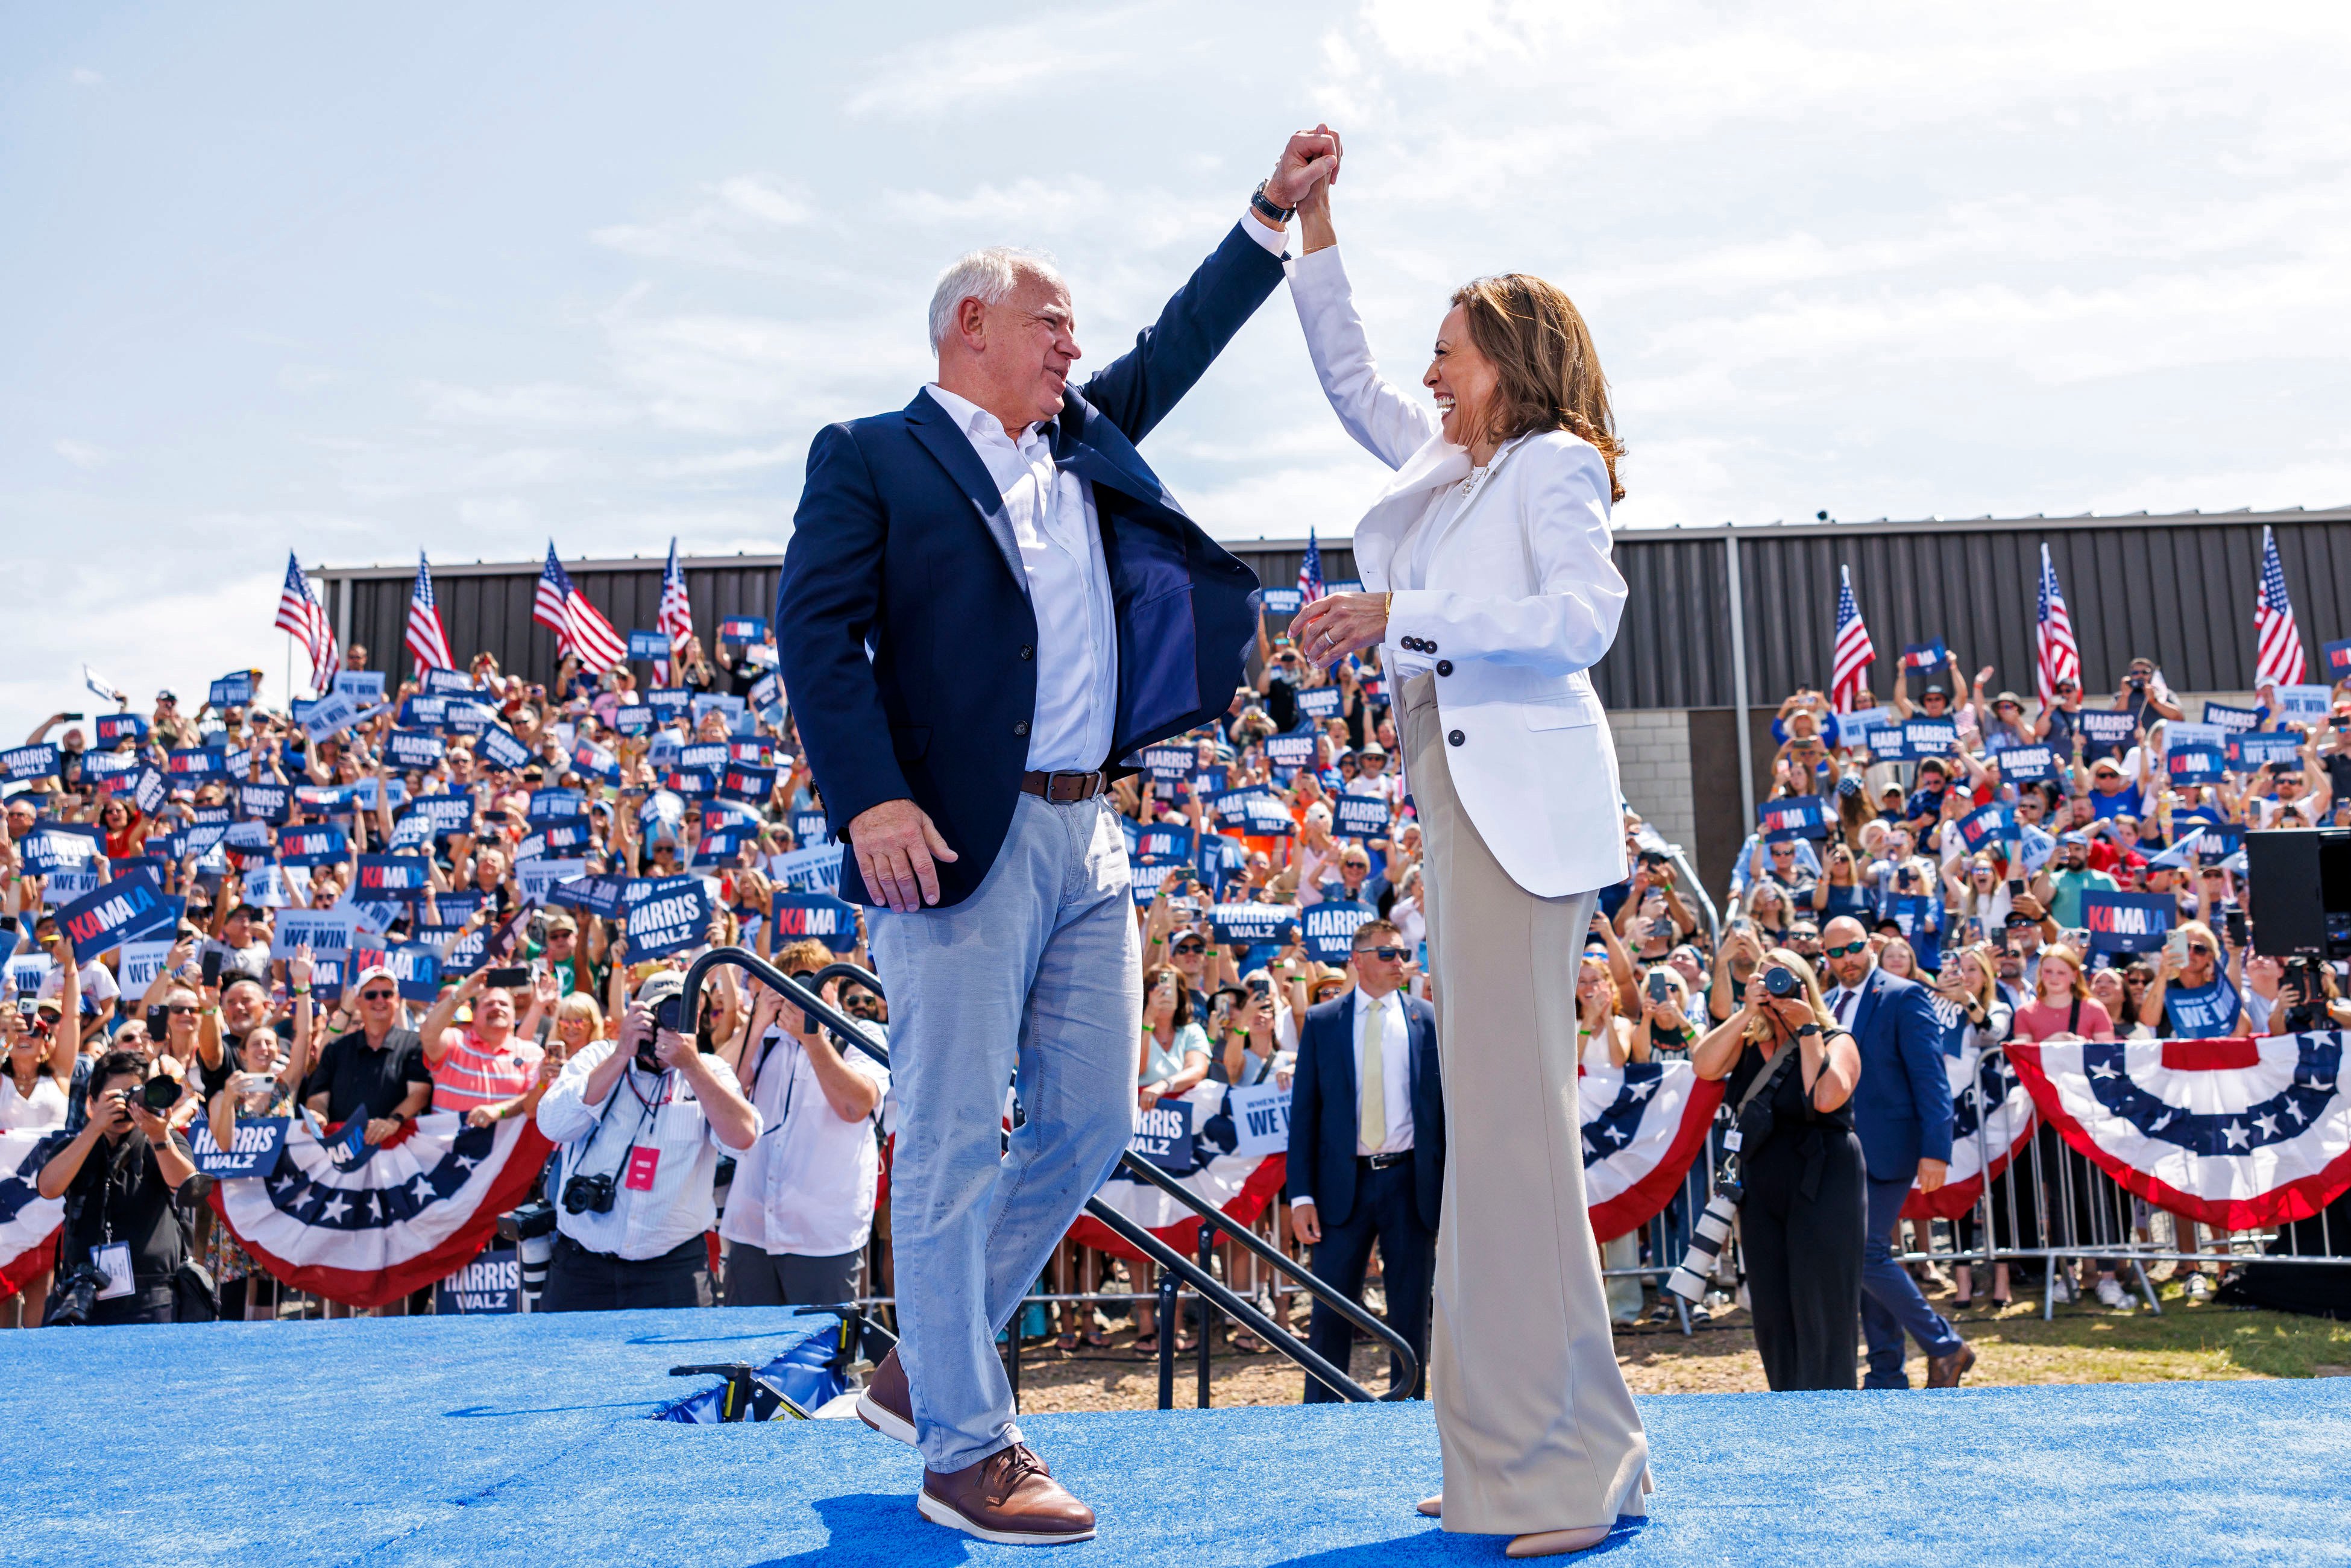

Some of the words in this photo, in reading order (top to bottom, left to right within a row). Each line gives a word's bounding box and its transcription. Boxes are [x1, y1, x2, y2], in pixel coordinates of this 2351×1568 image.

[2083, 713, 2135, 732] HARRIS
[682, 747, 728, 766] HARRIS
[1267, 737, 1314, 758] HARRIS
[171, 754, 222, 772] KAMALA
[1145, 752, 1194, 769] HARRIS
[2000, 748, 2051, 769] HARRIS
[2171, 753, 2223, 773] KAMALA
[13, 764, 46, 778] WALZ
[243, 786, 285, 808] HARRIS
[1339, 801, 1388, 823] HARRIS
[1765, 806, 1819, 831] KAMALA
[435, 818, 461, 829] ALZ
[798, 817, 826, 835] HAR
[1345, 820, 1380, 833] WALZ
[284, 833, 345, 855] KAMALA
[39, 855, 81, 868] WALZ
[787, 861, 811, 872] WHEN
[829, 853, 842, 861] VOT
[55, 875, 77, 890] WE
[362, 866, 425, 889] KAMALA
[68, 886, 156, 944] KAMALA
[628, 893, 700, 936] HARRIS
[779, 908, 855, 935] KAMALA
[2088, 905, 2168, 935] KAMALA
[284, 928, 309, 947] WE
[313, 929, 347, 949] WIN
[638, 923, 693, 950] WALZ
[1228, 925, 1276, 938] WALZ
[357, 948, 432, 984] KAMALA
[443, 954, 473, 967] ALZ
[128, 963, 151, 984] WE
[2176, 1005, 2215, 1028] WE
[1247, 1098, 1275, 1108] WHEN
[1247, 1108, 1279, 1137] WE
[203, 1154, 257, 1170] WALZ
[444, 1261, 519, 1292] HARRIS
[456, 1292, 508, 1309] WALZ
